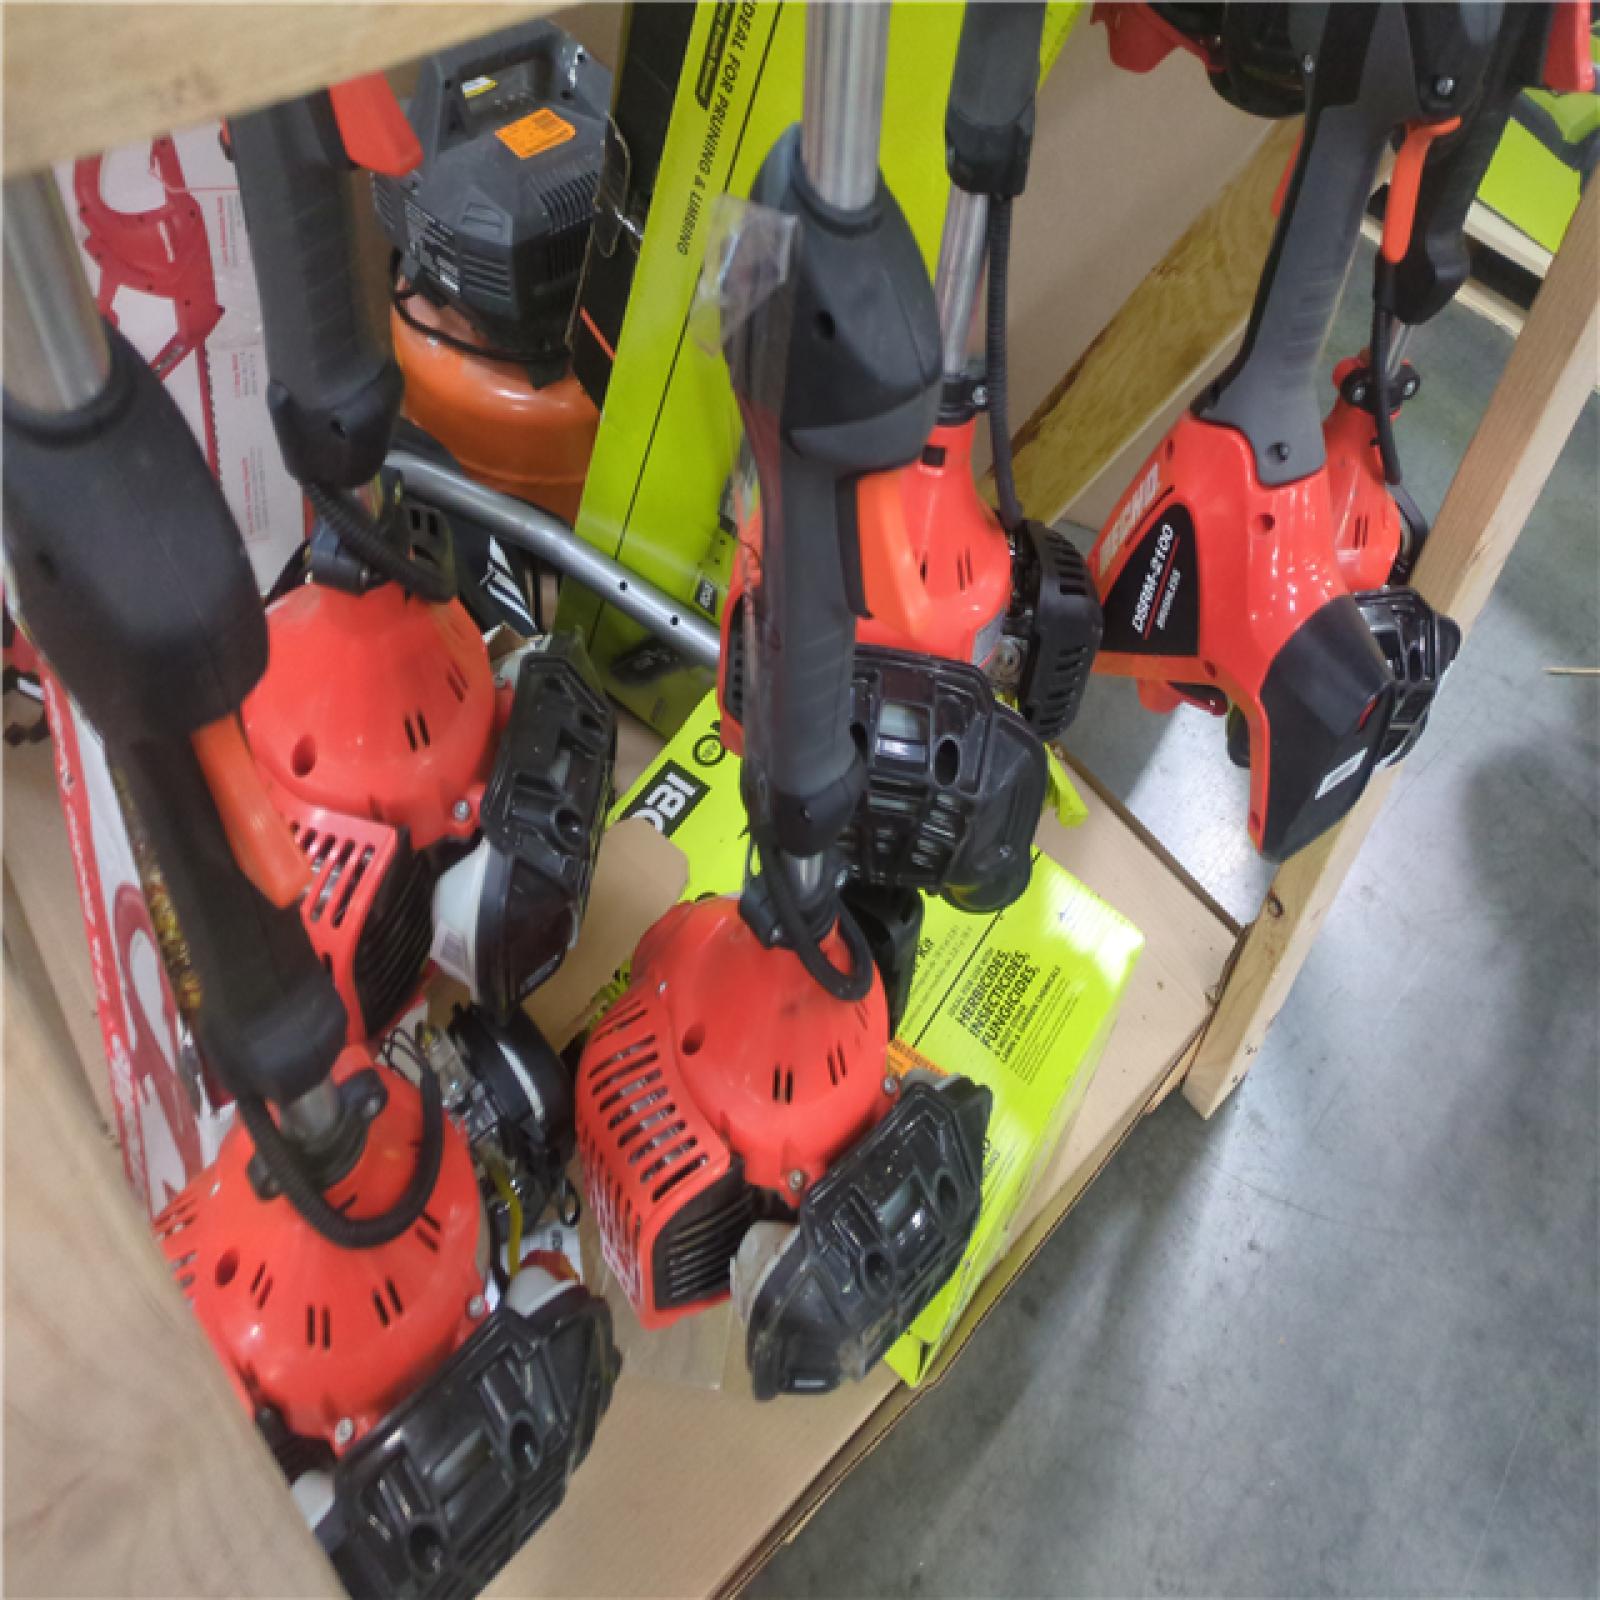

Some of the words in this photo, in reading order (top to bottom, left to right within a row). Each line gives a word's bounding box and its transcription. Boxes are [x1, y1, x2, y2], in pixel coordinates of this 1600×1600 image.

[720, 52, 741, 93] FOR
[699, 91, 730, 176] PRUNING
[676, 190, 703, 256] LIMBING
